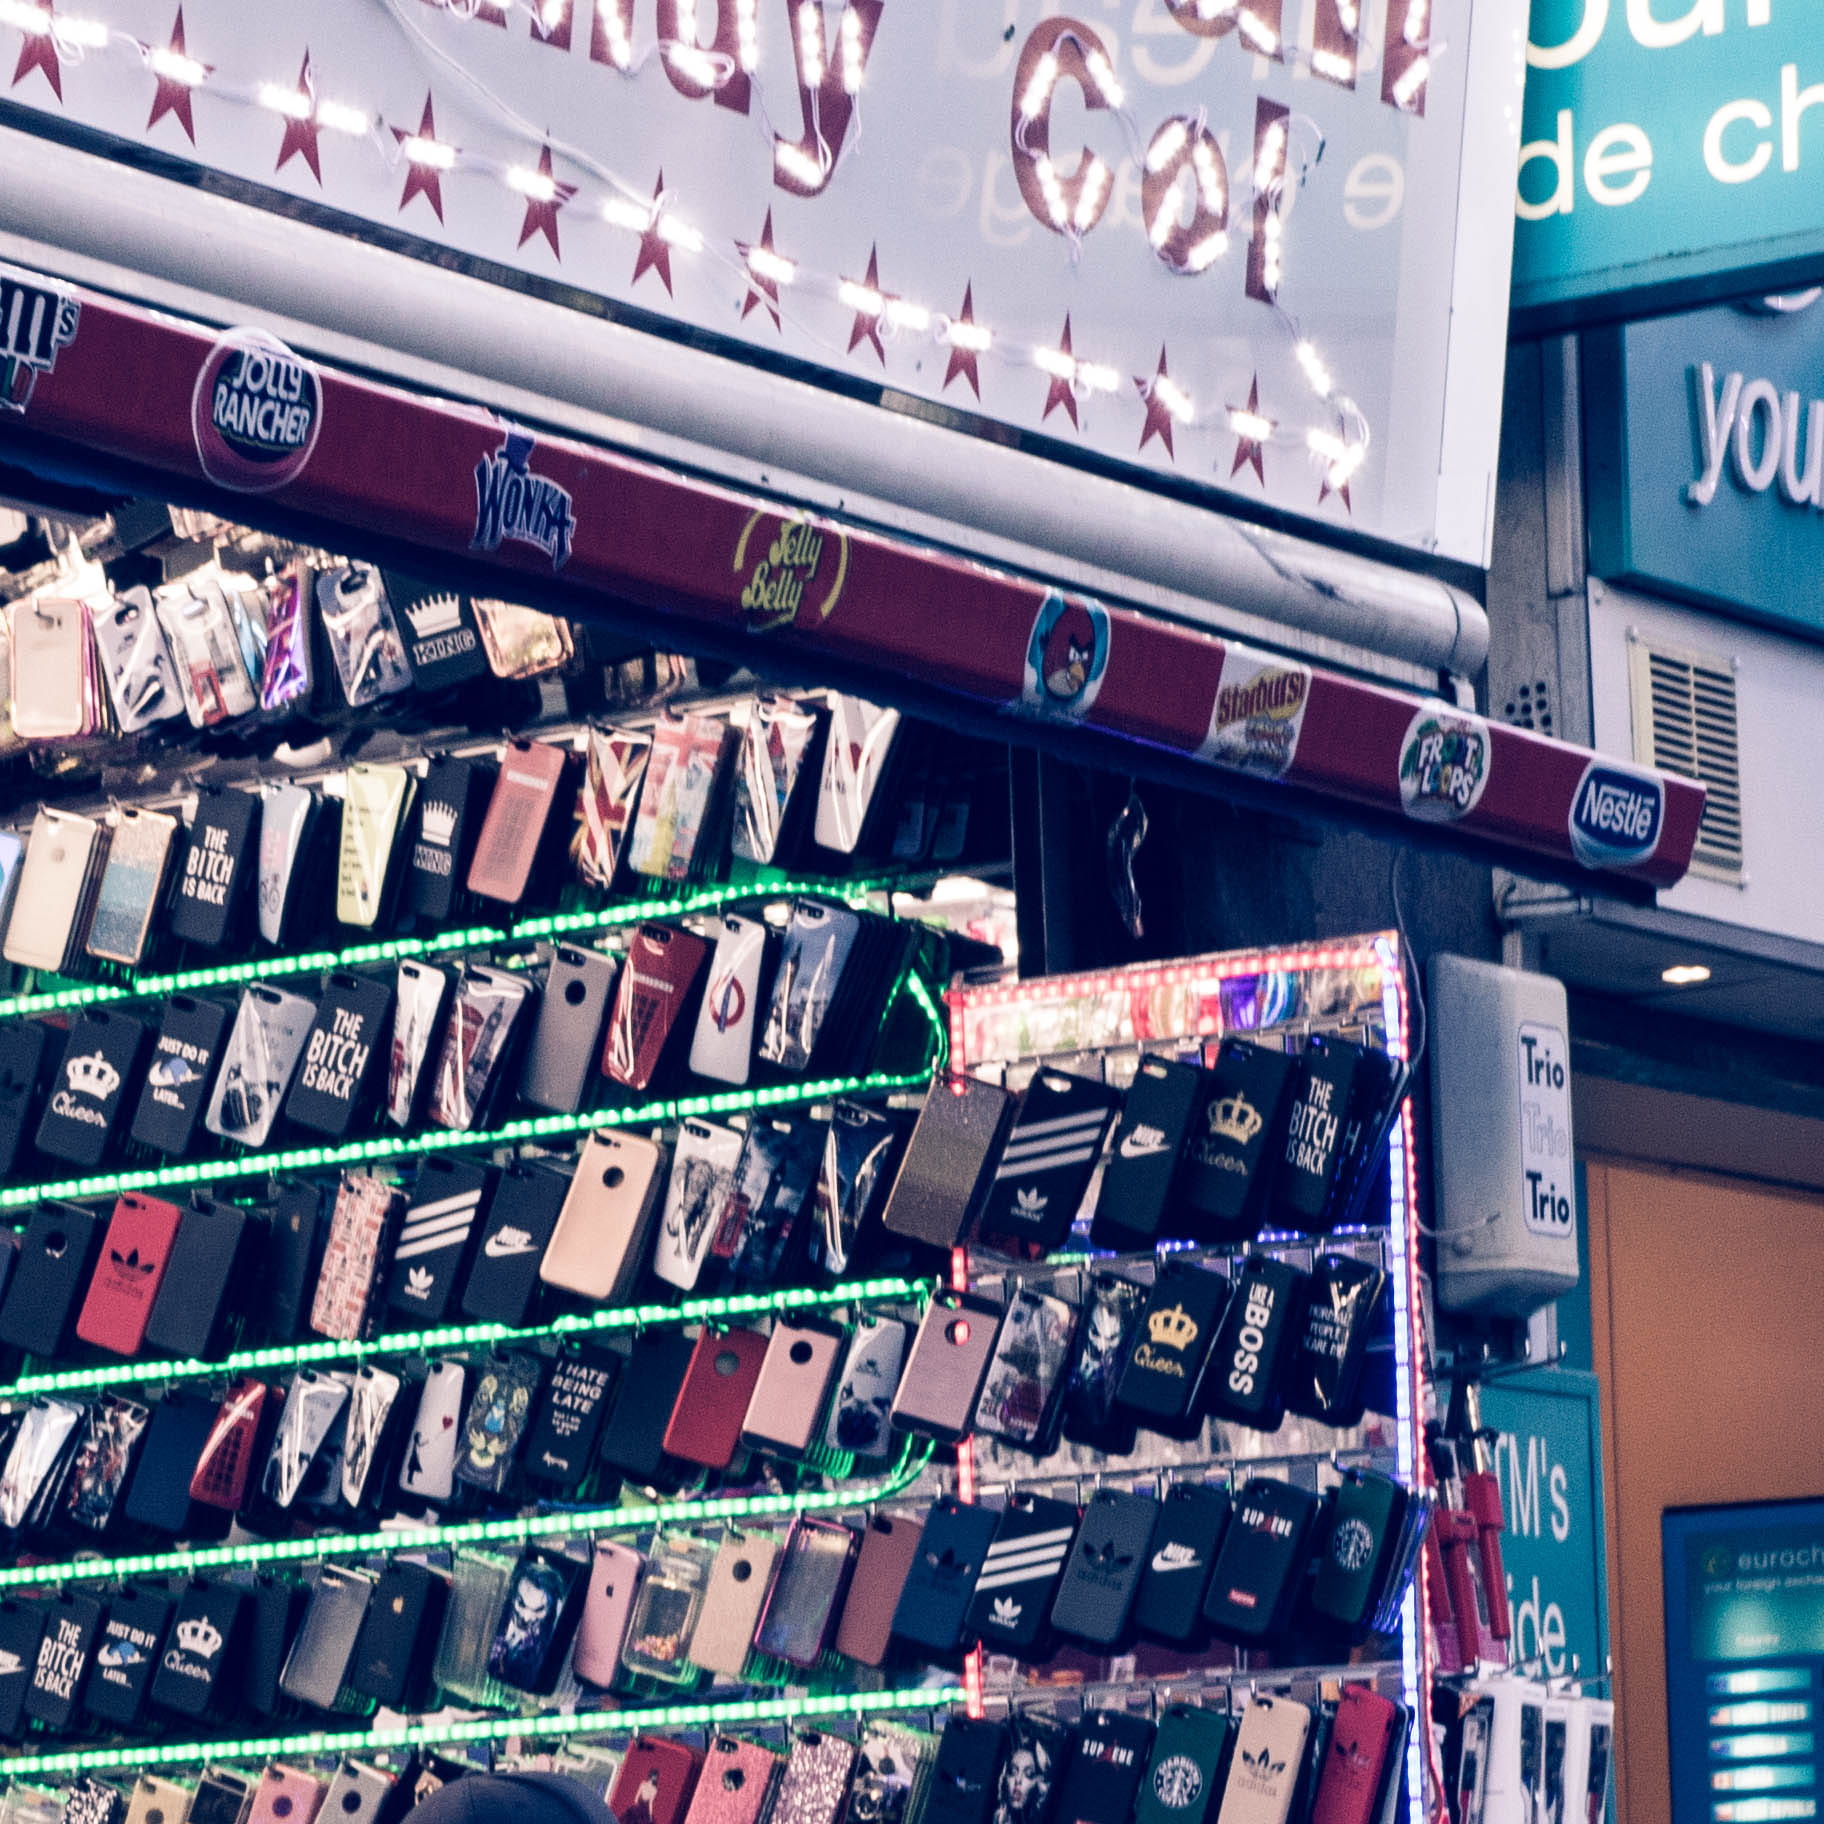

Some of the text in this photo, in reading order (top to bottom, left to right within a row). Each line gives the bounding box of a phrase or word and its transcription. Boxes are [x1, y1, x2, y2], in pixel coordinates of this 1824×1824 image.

[1516, 108, 1652, 220] de
[230, 348, 304, 397] JOLLY
[212, 384, 311, 445] RANCHER
[769, 519, 822, 581] Jelly
[738, 560, 806, 629] Belly
[411, 627, 476, 668] KING
[1216, 671, 1308, 730] Starburst
[203, 824, 229, 853] THE
[182, 876, 227, 908] IS BACK
[186, 850, 234, 898] BITCH
[333, 1006, 364, 1044] THE
[307, 1036, 370, 1080] BITCH
[1520, 1036, 1566, 1091] Trio
[303, 1063, 355, 1099] IS BACK
[1307, 1076, 1331, 1107] THE
[52, 1091, 107, 1131] Queen
[1288, 1104, 1335, 1148] BITCH
[1522, 1100, 1569, 1158] Trio
[1184, 1137, 1249, 1176] Queen
[1285, 1137, 1327, 1177] IS BACK
[1524, 1171, 1571, 1226] Trio
[1135, 1344, 1185, 1377] Queen
[1229, 1301, 1271, 1397] BOSS
[552, 1375, 602, 1401] BEING
[552, 1391, 594, 1416] LATE
[57, 1618, 81, 1648] THE
[38, 1640, 86, 1679] BITCH
[164, 1652, 213, 1684] Queen
